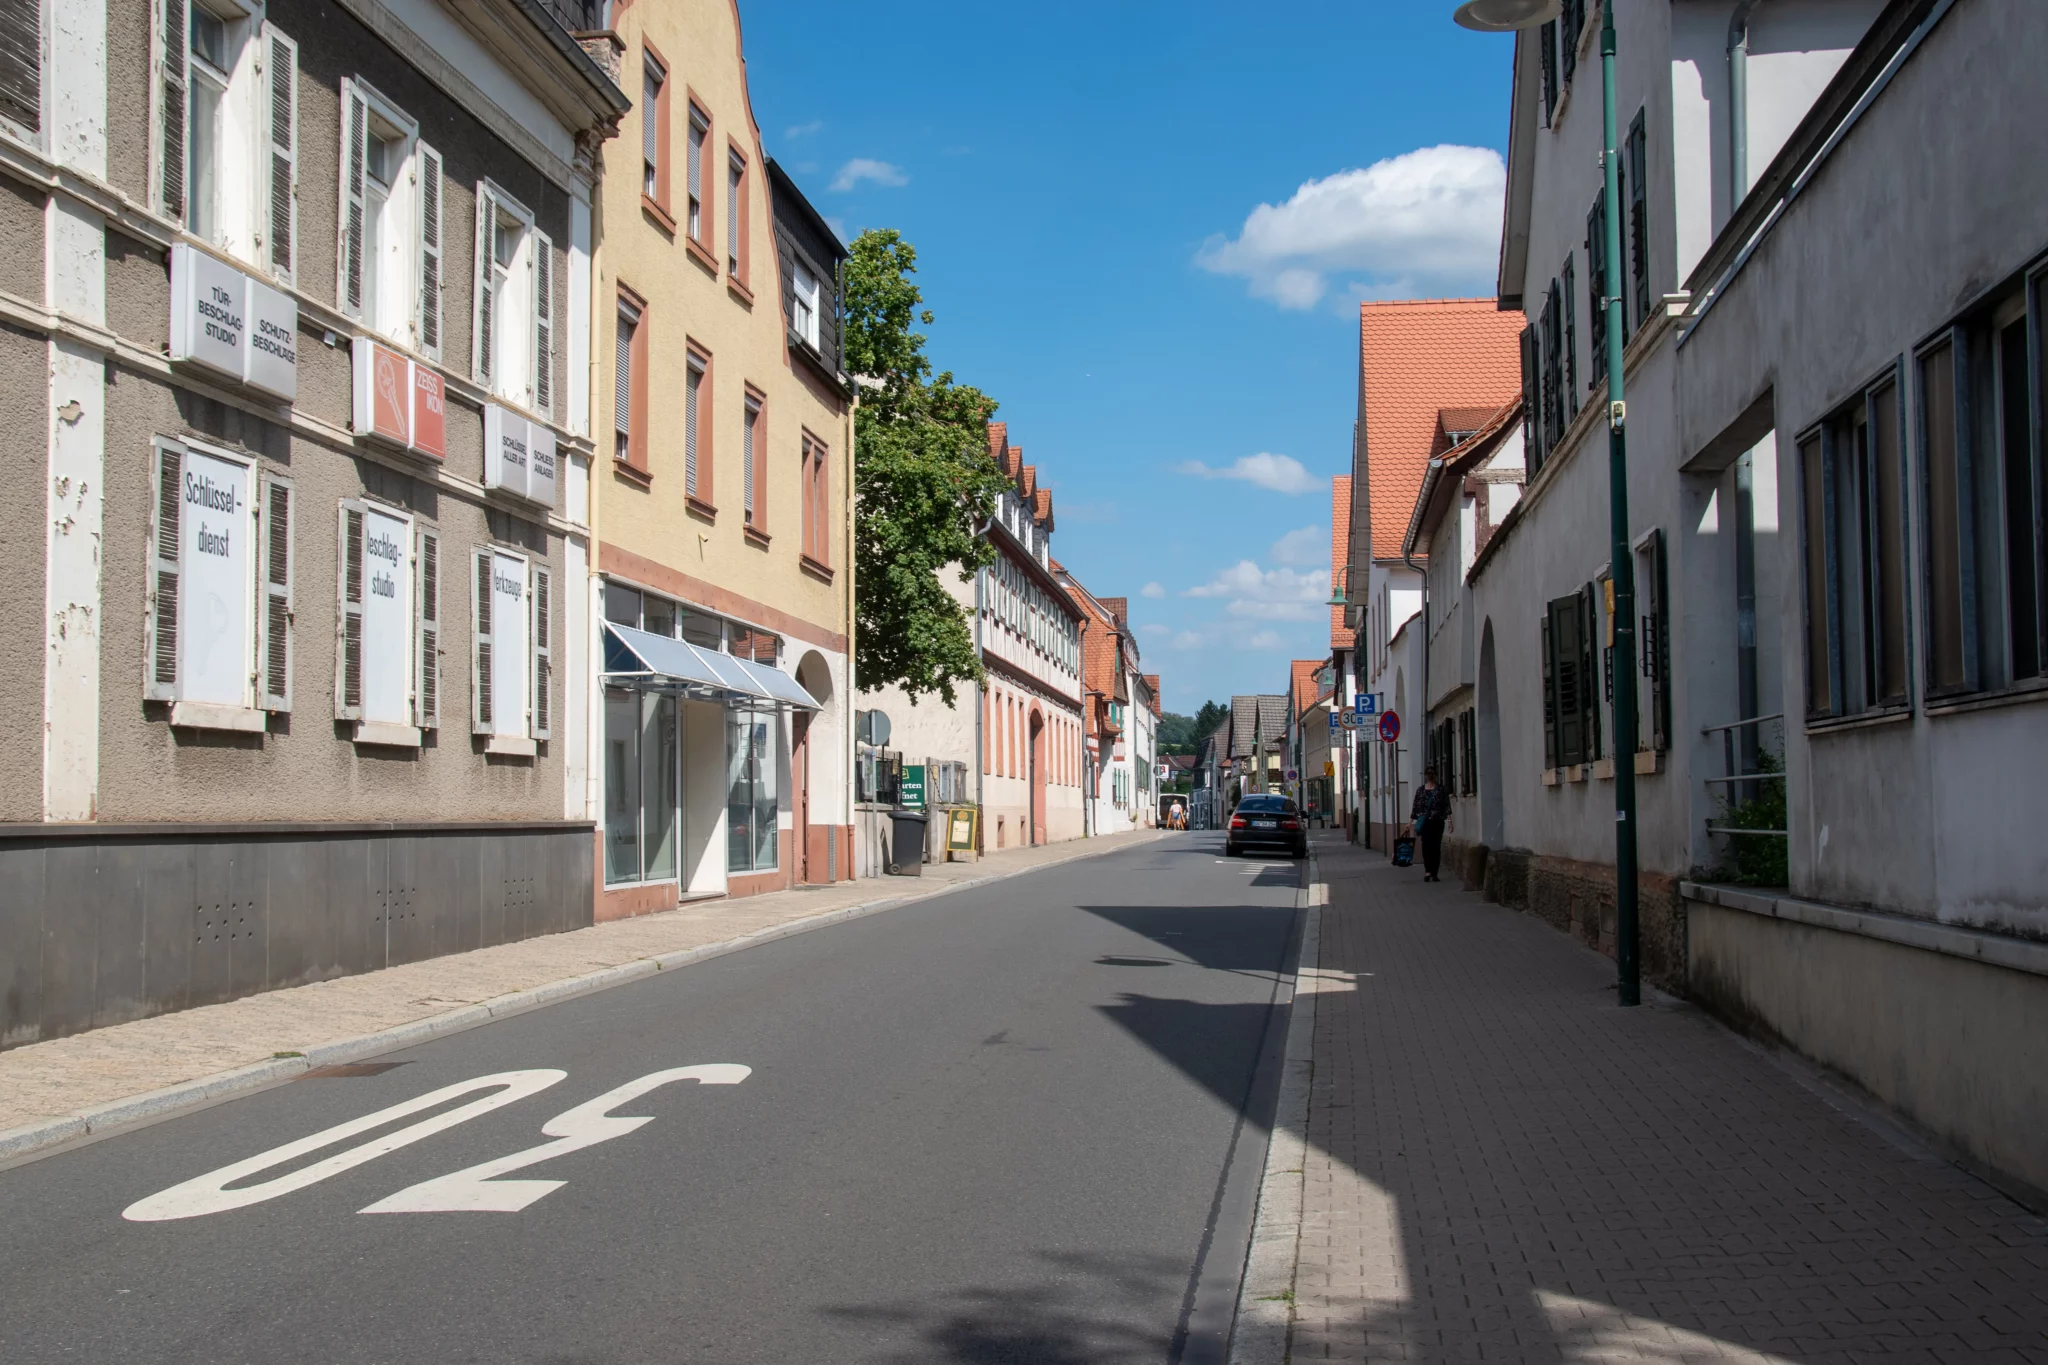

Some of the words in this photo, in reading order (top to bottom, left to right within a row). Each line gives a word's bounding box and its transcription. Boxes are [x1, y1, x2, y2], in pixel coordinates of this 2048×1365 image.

[211, 286, 232, 307] TÜR-
[198, 300, 243, 331] BESCHLAG-
[205, 322, 237, 346] STUDIO
[259, 319, 292, 344] SCHUTZ-
[252, 334, 295, 364] BESCHLÄGE
[417, 369, 438, 395] ZEISS
[426, 392, 443, 415] IKON
[503, 450, 518, 464] ALLER
[518, 456, 526, 468] ART
[534, 463, 554, 480] ANLAGEN
[198, 521, 230, 557] dienst
[367, 529, 402, 568] eschlag-
[371, 570, 395, 598] studio
[1359, 696, 1371, 713] P
[1343, 712, 1356, 724] 30
[121, 1062, 753, 1222] 30
